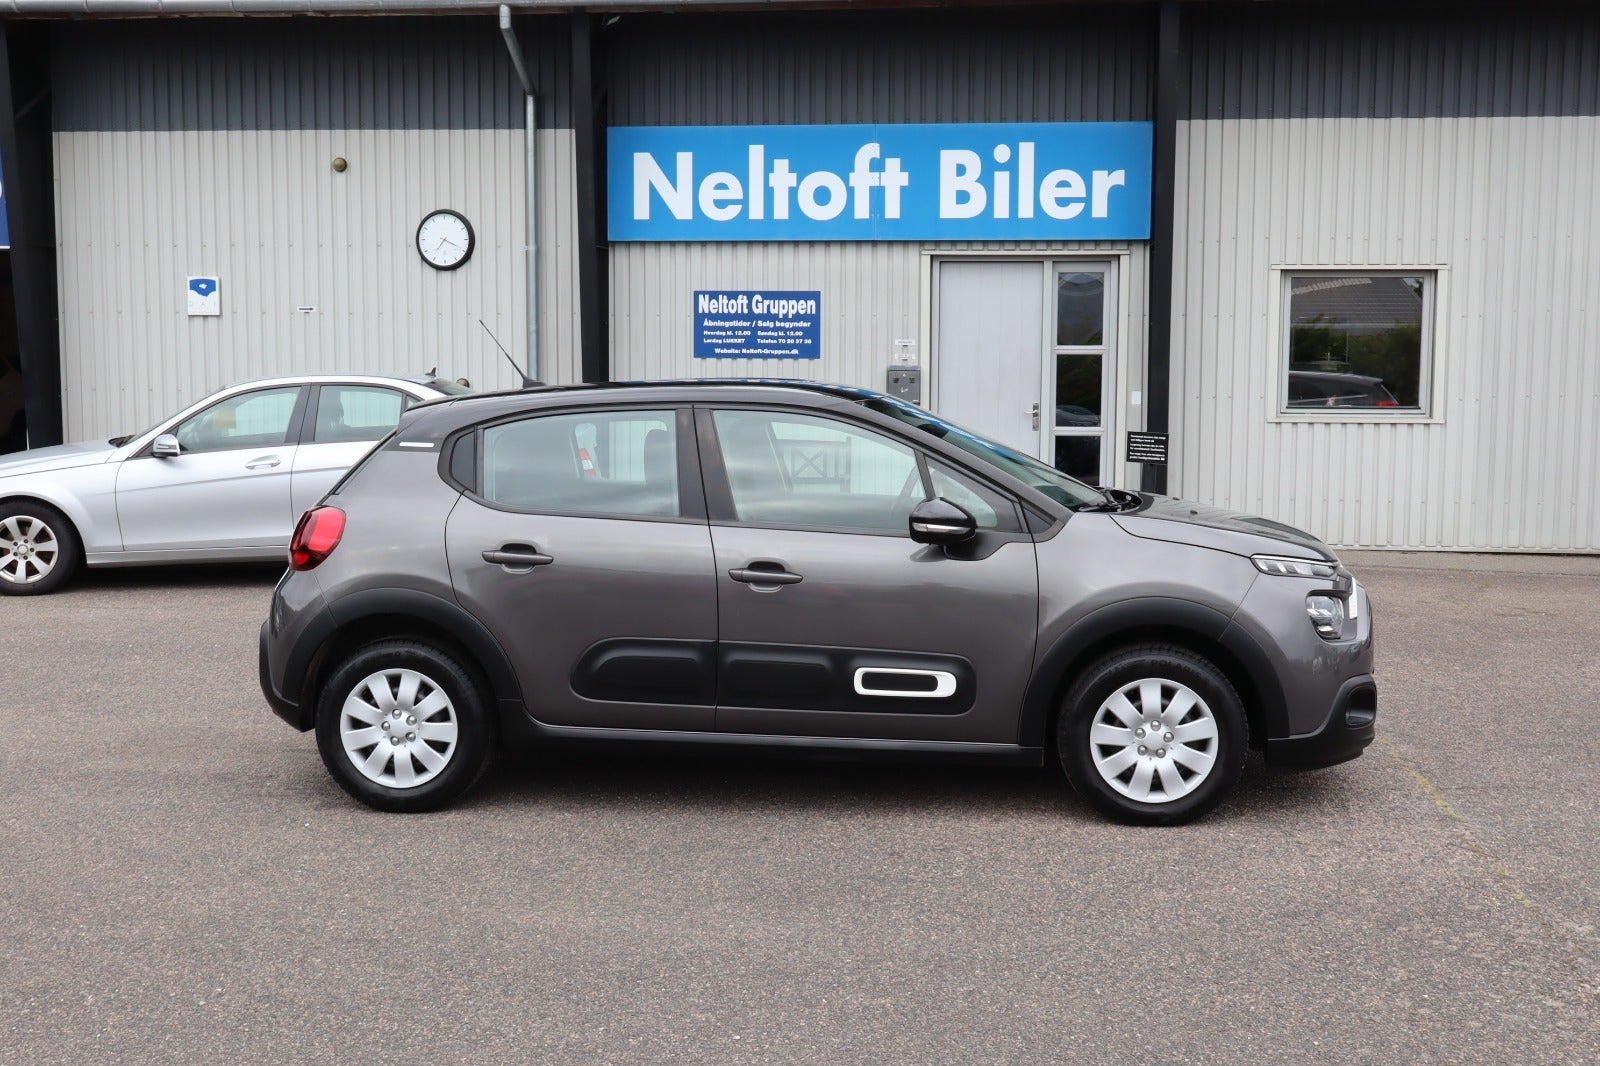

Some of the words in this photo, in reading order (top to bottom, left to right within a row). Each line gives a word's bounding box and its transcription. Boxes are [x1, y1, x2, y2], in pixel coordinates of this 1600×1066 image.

[633, 143, 909, 221] Neltoft
[939, 142, 1125, 220] Biler
[698, 294, 748, 314] Neltoft
[752, 294, 816, 318] Gruppen
[703, 318, 751, 328] Åbningstider
[757, 320, 774, 328] Salg
[775, 320, 811, 329] begynder
